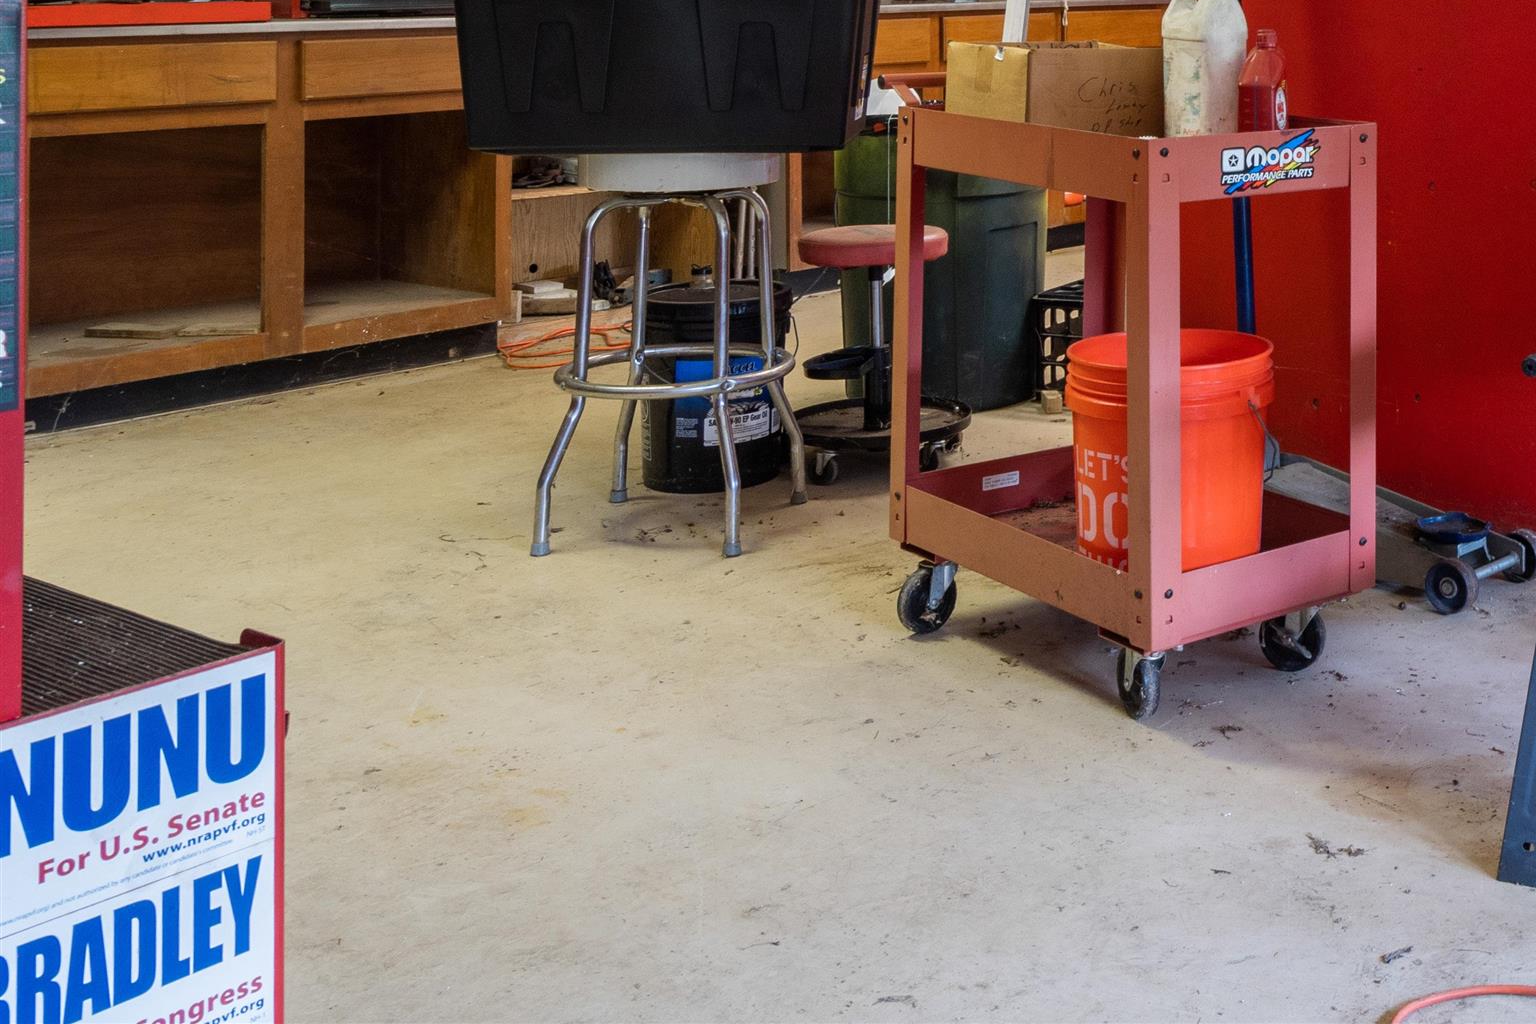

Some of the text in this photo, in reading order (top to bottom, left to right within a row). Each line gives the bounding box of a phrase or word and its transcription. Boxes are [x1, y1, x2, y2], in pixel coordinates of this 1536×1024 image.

[1078, 76, 1137, 103] Chris
[1222, 167, 1313, 184] PERFORMANCE PARTS
[37, 792, 265, 884] For U.S. Senate
[143, 812, 266, 863] www.nrapvf.org
[0, 855, 262, 1024] RADLEY
